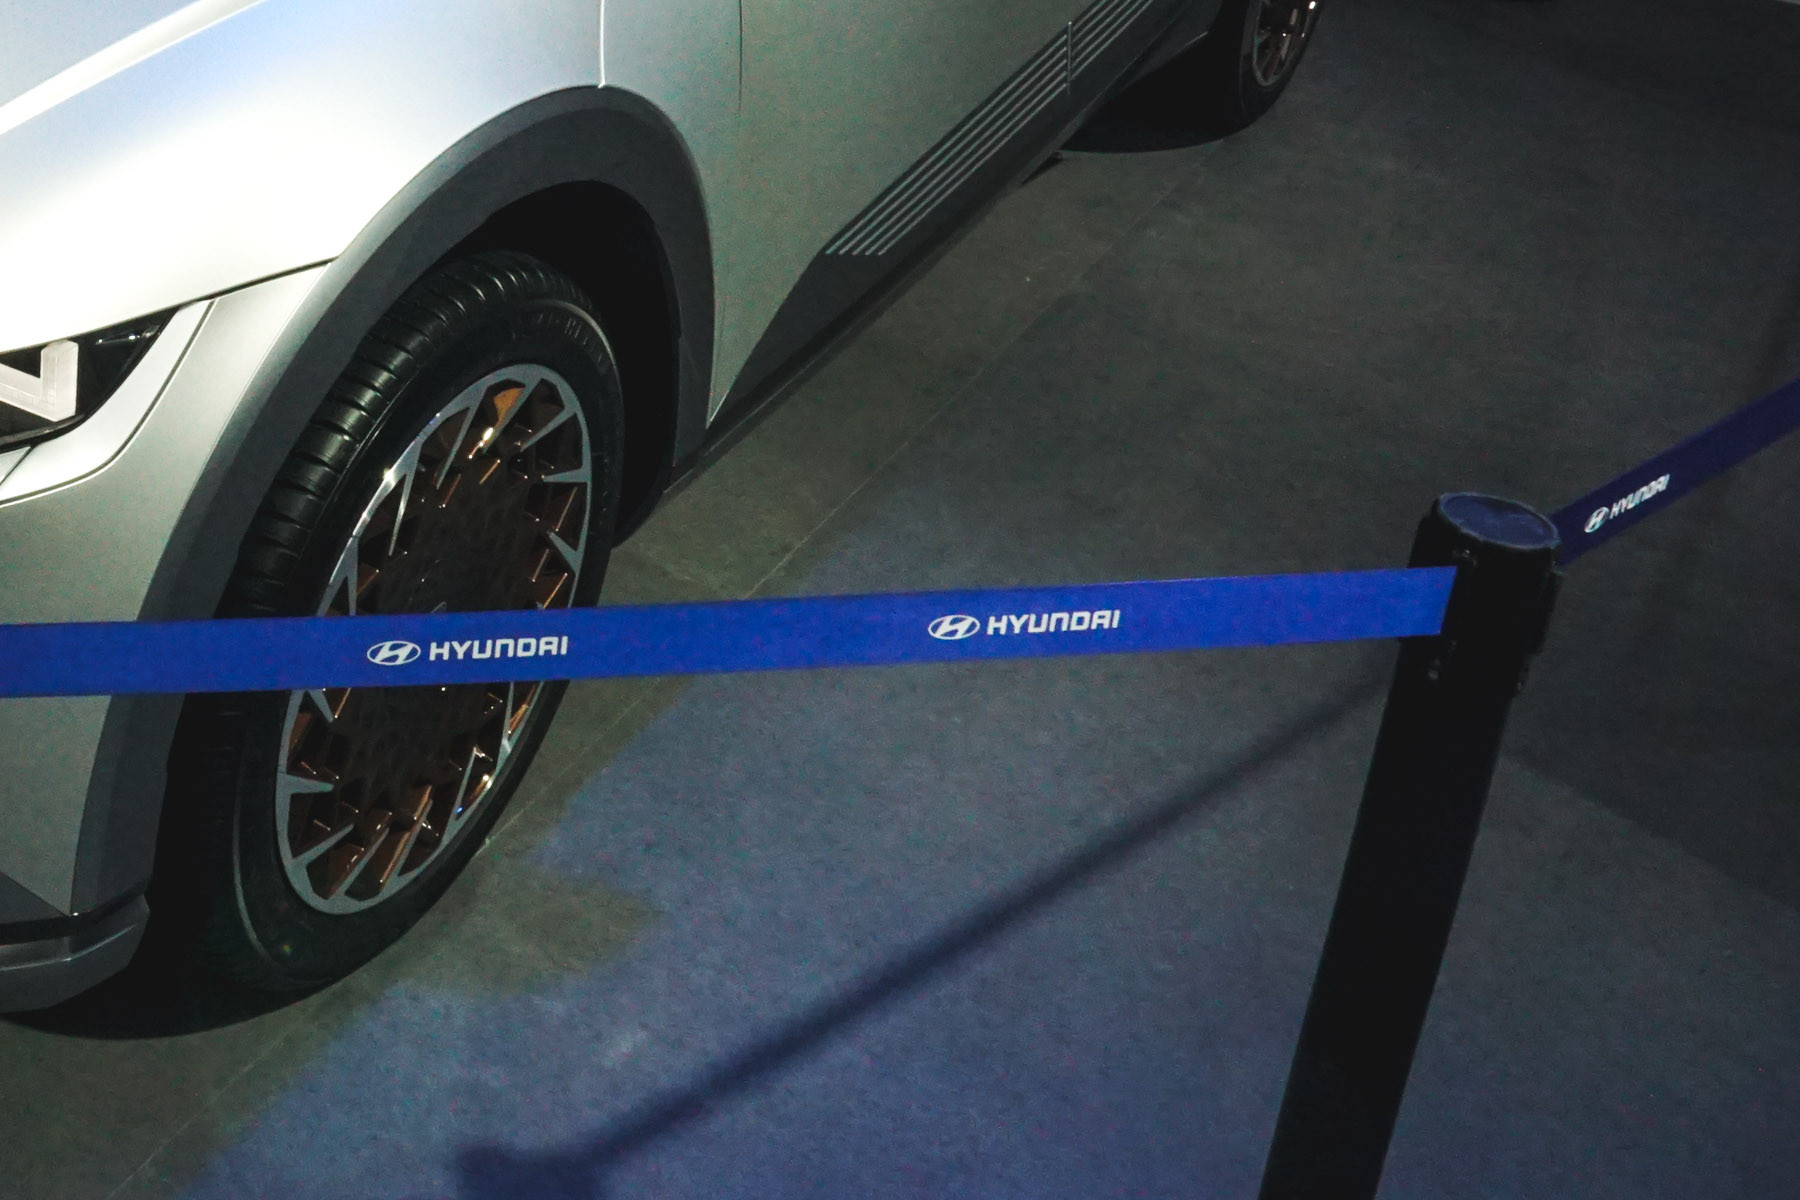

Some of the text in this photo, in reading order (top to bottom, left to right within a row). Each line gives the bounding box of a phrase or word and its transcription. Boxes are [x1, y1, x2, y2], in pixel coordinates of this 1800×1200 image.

[1609, 473, 1670, 520] HYUNDAI
[987, 610, 1120, 635] HYUNDAI
[429, 636, 568, 661] HYUNDAI
